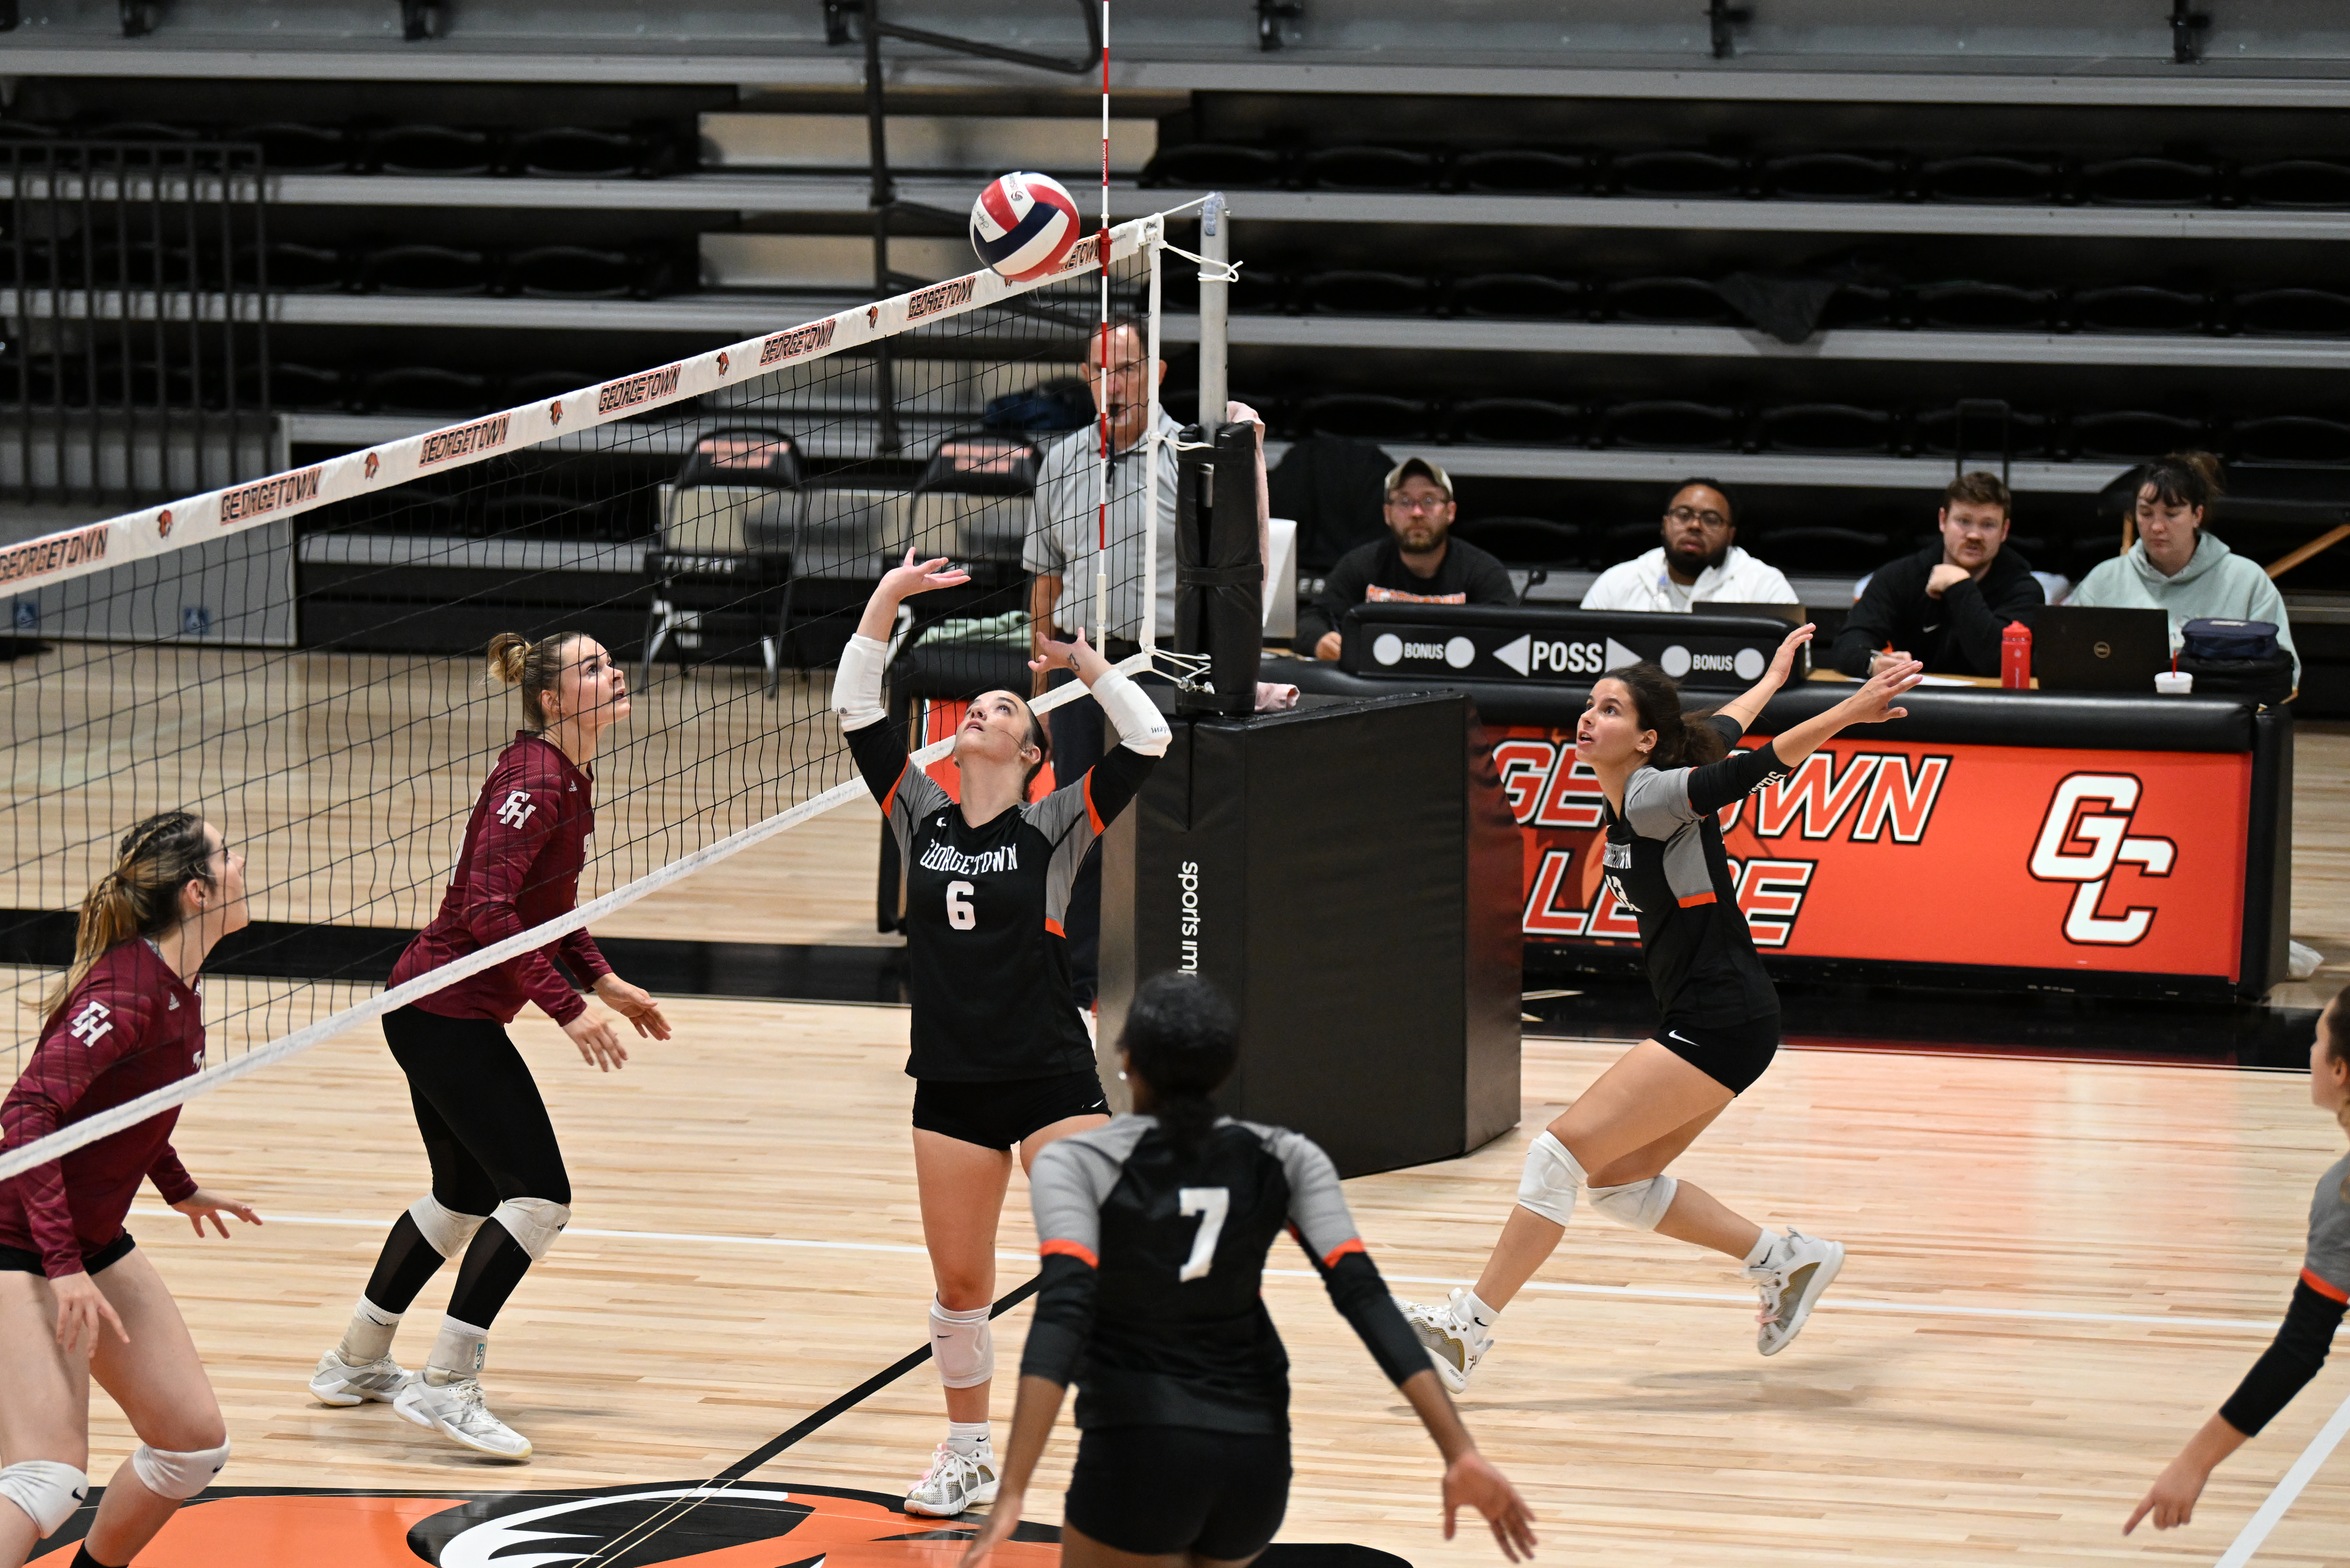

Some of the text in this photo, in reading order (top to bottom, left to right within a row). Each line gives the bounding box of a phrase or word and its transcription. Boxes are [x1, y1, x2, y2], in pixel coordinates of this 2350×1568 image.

[906, 276, 976, 320] GEORGETOWN
[760, 318, 836, 366] GEORGETOWN
[599, 363, 681, 415] GEORGETOWN
[419, 413, 511, 468] GEORGETOWN
[220, 467, 322, 525] GEORGETOWN
[0, 524, 109, 584] GEORGETOWN
[1403, 642, 1444, 661] BONUS
[1531, 640, 1604, 674] POSS
[1692, 653, 1733, 672] BONUS
[2029, 772, 2177, 946] GC
[946, 880, 976, 931] 6
[1177, 860, 1201, 937] sports
[1179, 1186, 1230, 1283] 7
